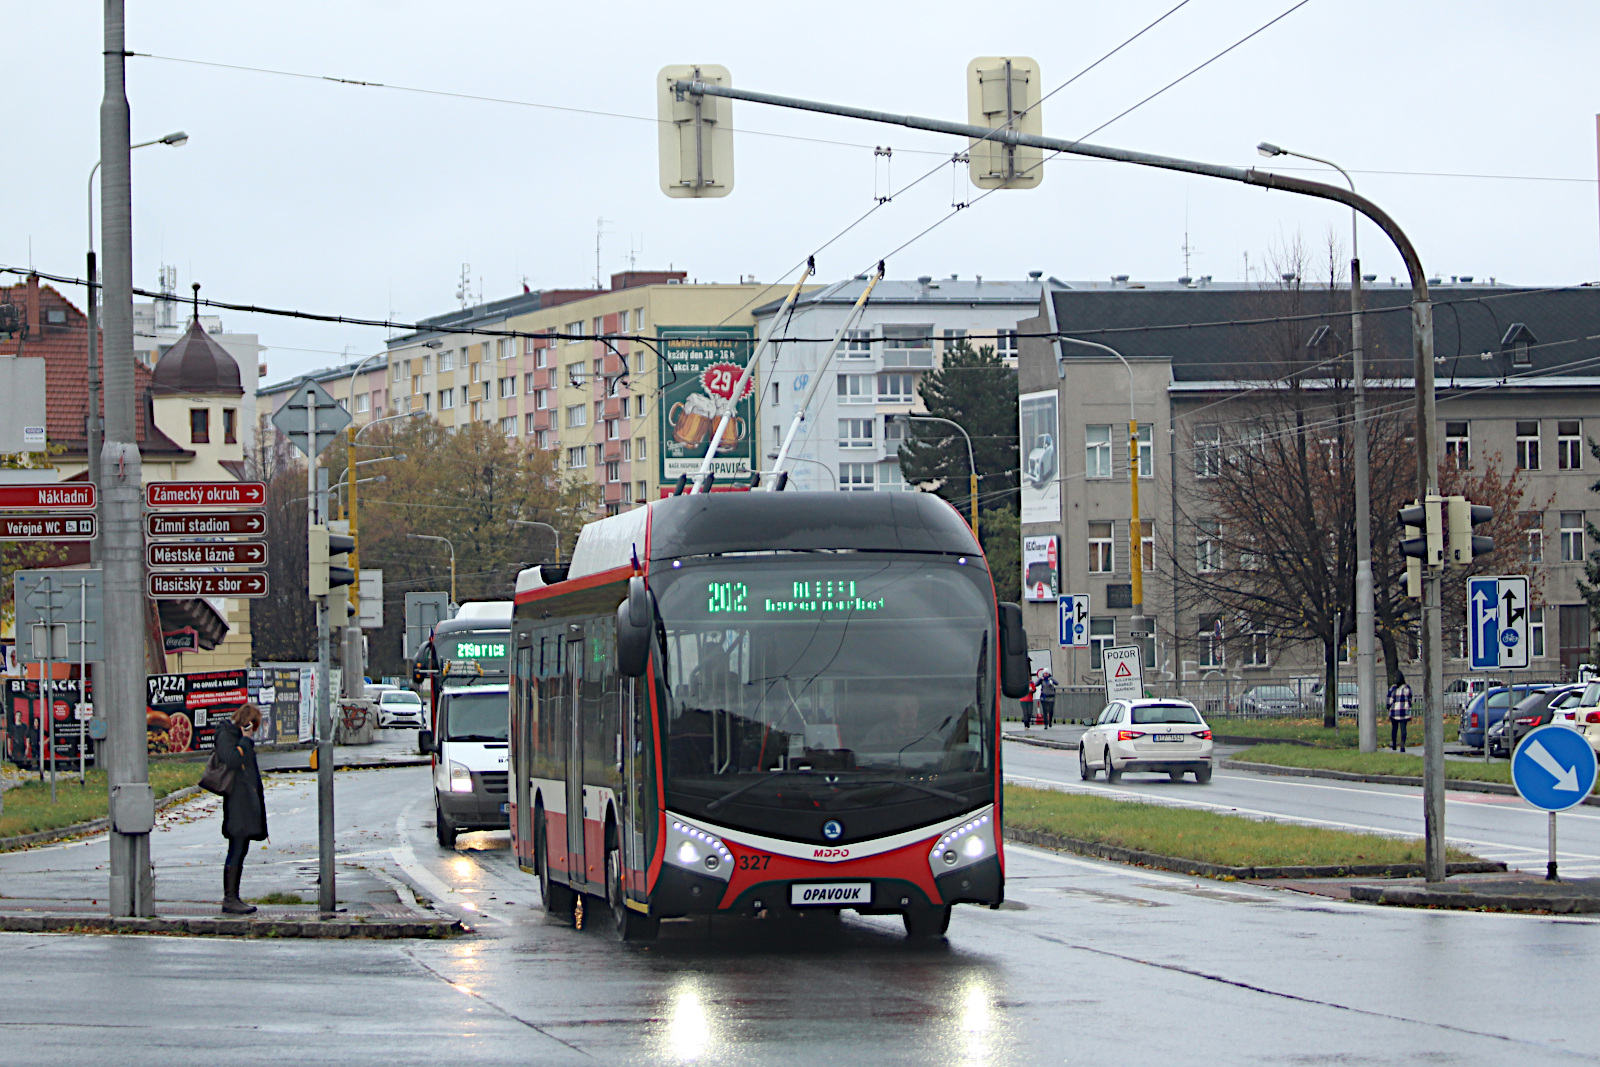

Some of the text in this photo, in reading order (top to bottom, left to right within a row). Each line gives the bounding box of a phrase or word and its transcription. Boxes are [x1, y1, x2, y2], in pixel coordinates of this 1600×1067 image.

[668, 350, 689, 360] každý
[690, 350, 703, 359] den
[705, 350, 714, 359] 10
[720, 350, 729, 359] 16
[674, 362, 689, 371] akci
[710, 369, 732, 392] 29
[38, 489, 88, 504] Nákladní
[154, 486, 240, 504] Zámecký okruh
[7, 520, 60, 536] Veřejné WC
[154, 518, 230, 532] Zimní stadion
[154, 547, 235, 562] Městské lázně
[154, 576, 242, 594] Hasičský z. sbor
[708, 582, 748, 612] 202
[1107, 650, 1136, 660] POZOR
[149, 676, 185, 694] PIZZA
[201, 680, 218, 688] OPAVĚ
[813, 848, 850, 858] MDPO
[739, 855, 772, 870] 327
[803, 887, 862, 901] OPAVOUK
